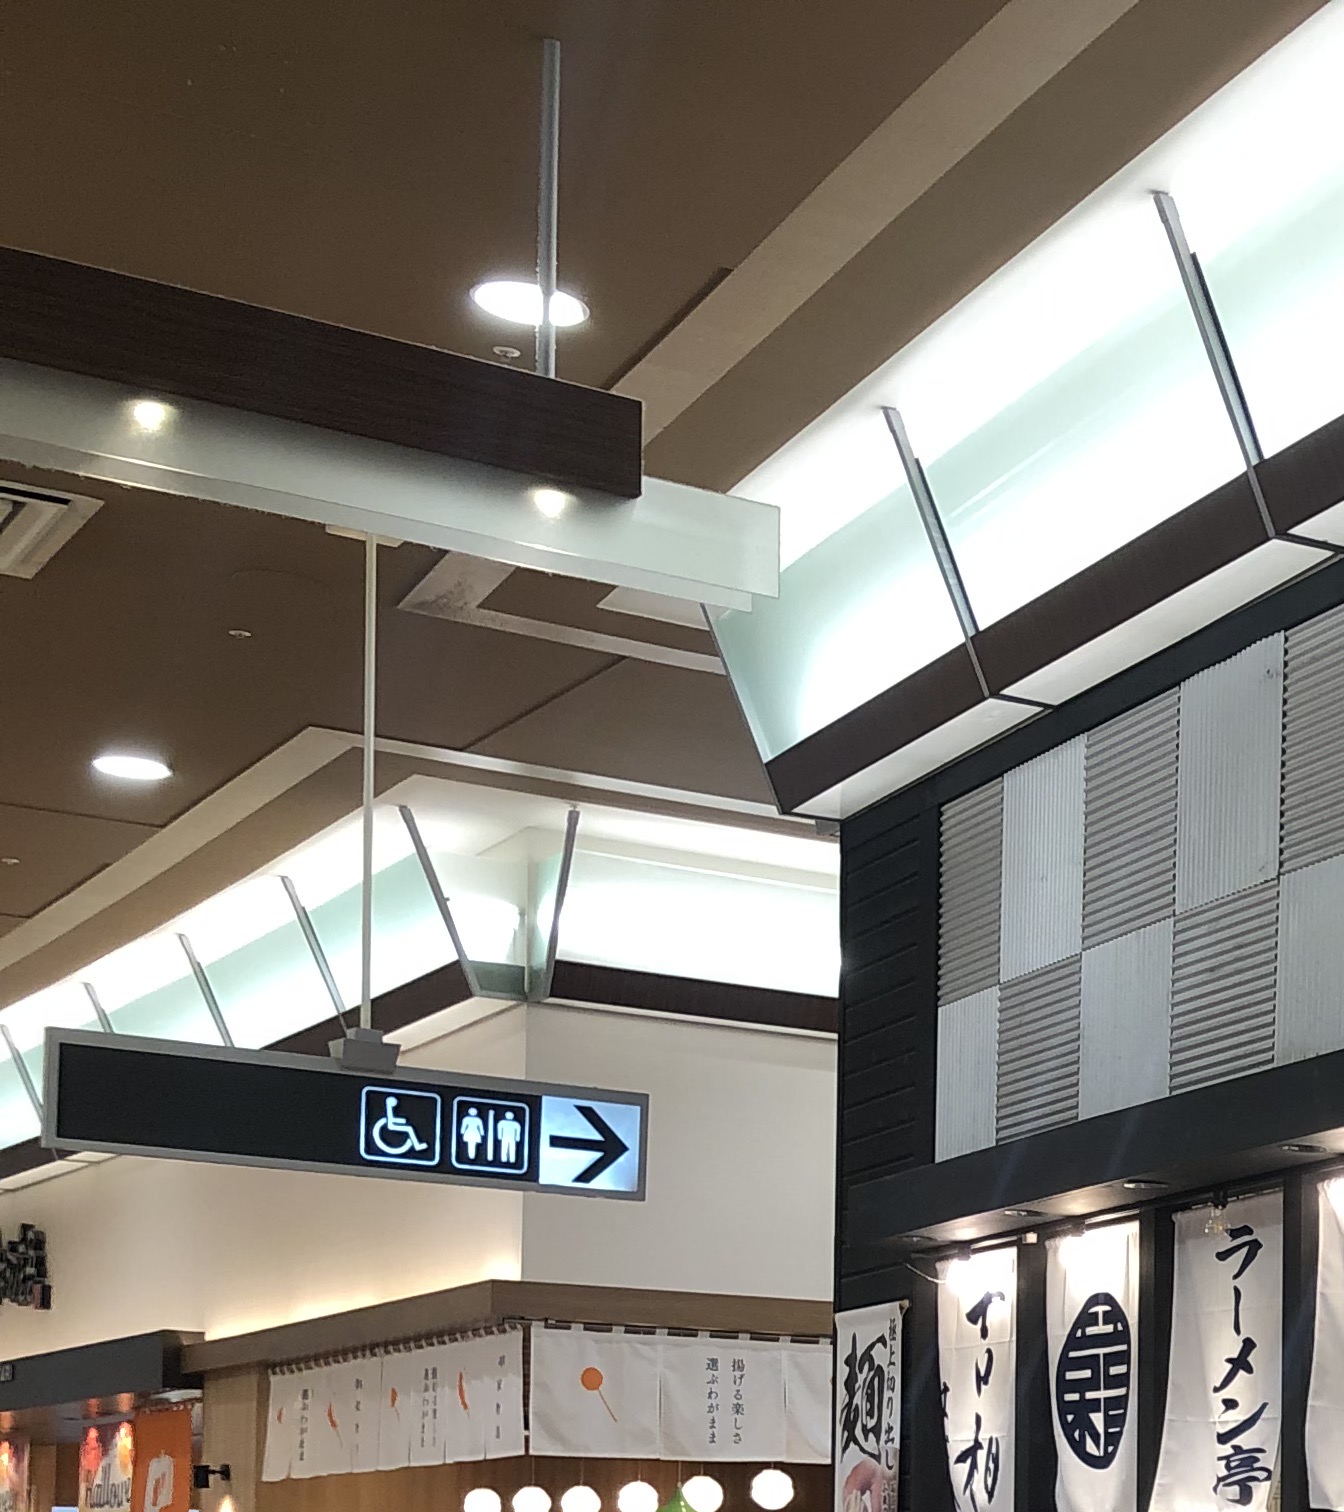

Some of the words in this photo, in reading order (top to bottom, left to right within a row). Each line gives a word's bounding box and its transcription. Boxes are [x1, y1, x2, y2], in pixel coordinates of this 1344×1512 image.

[705, 1357, 720, 1445] 選ぶわがまま
[731, 1357, 746, 1445] 揚げる楽しさ
[839, 1331, 889, 1465] 麺
[1211, 1223, 1273, 1507] ラーメン亭
